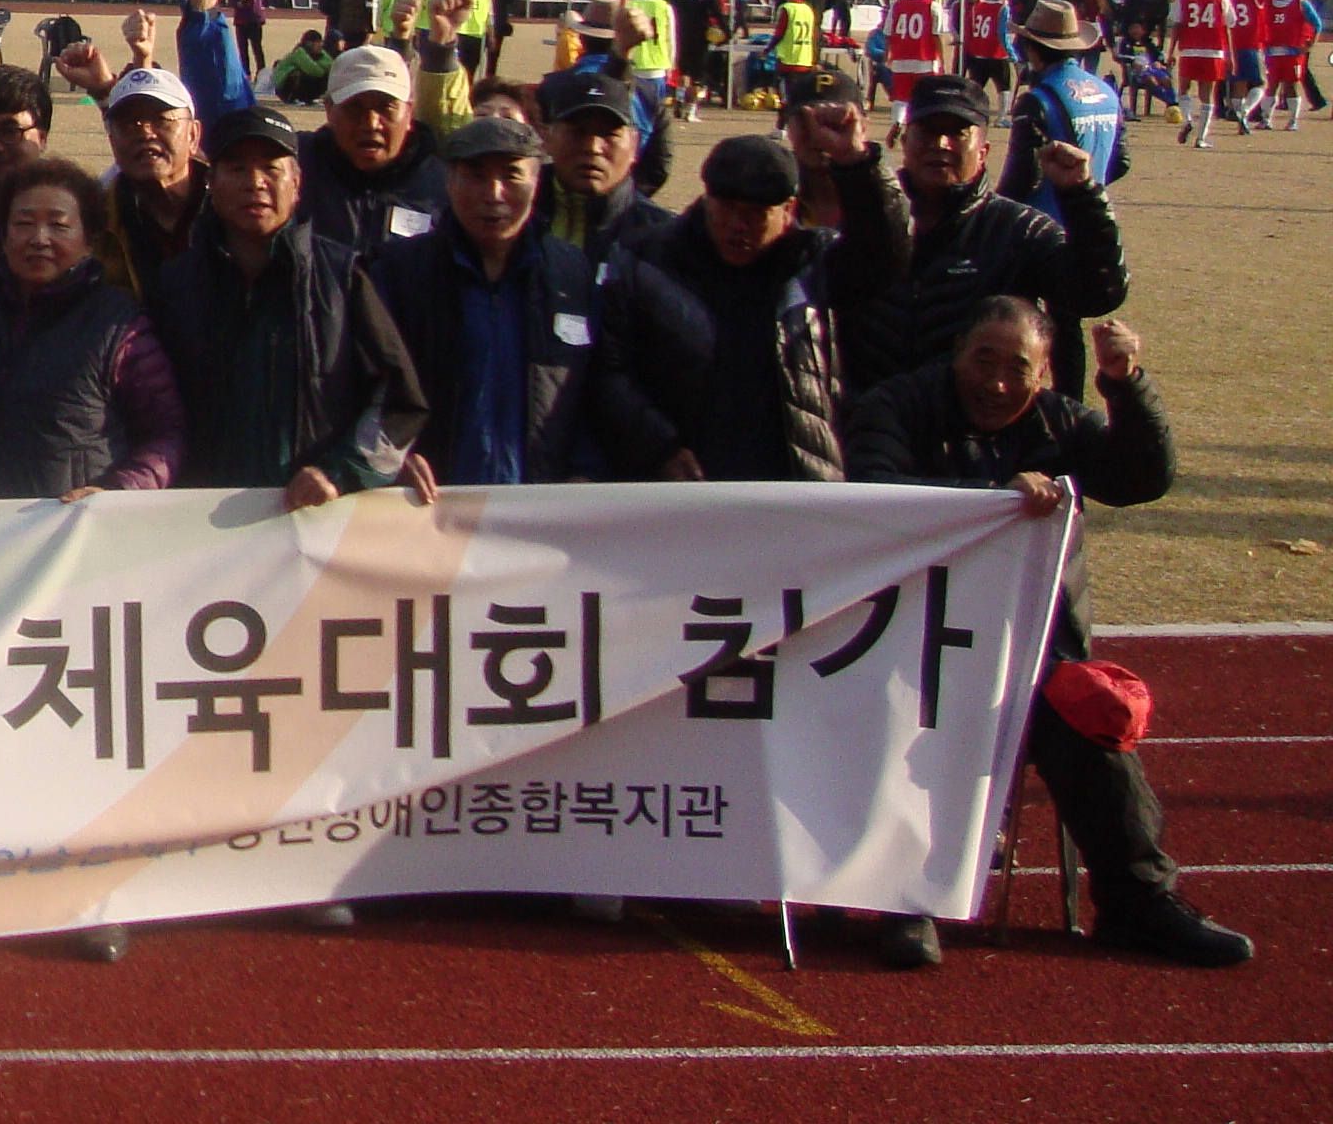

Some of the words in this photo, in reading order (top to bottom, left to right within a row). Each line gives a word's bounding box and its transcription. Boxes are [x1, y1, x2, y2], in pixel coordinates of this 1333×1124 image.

[895, 13, 923, 40] 40
[973, 14, 992, 38] 36
[1187, 2, 1215, 28] 34
[1235, 3, 1250, 26] 3
[816, 74, 835, 93] P
[679, 565, 975, 732] 참가
